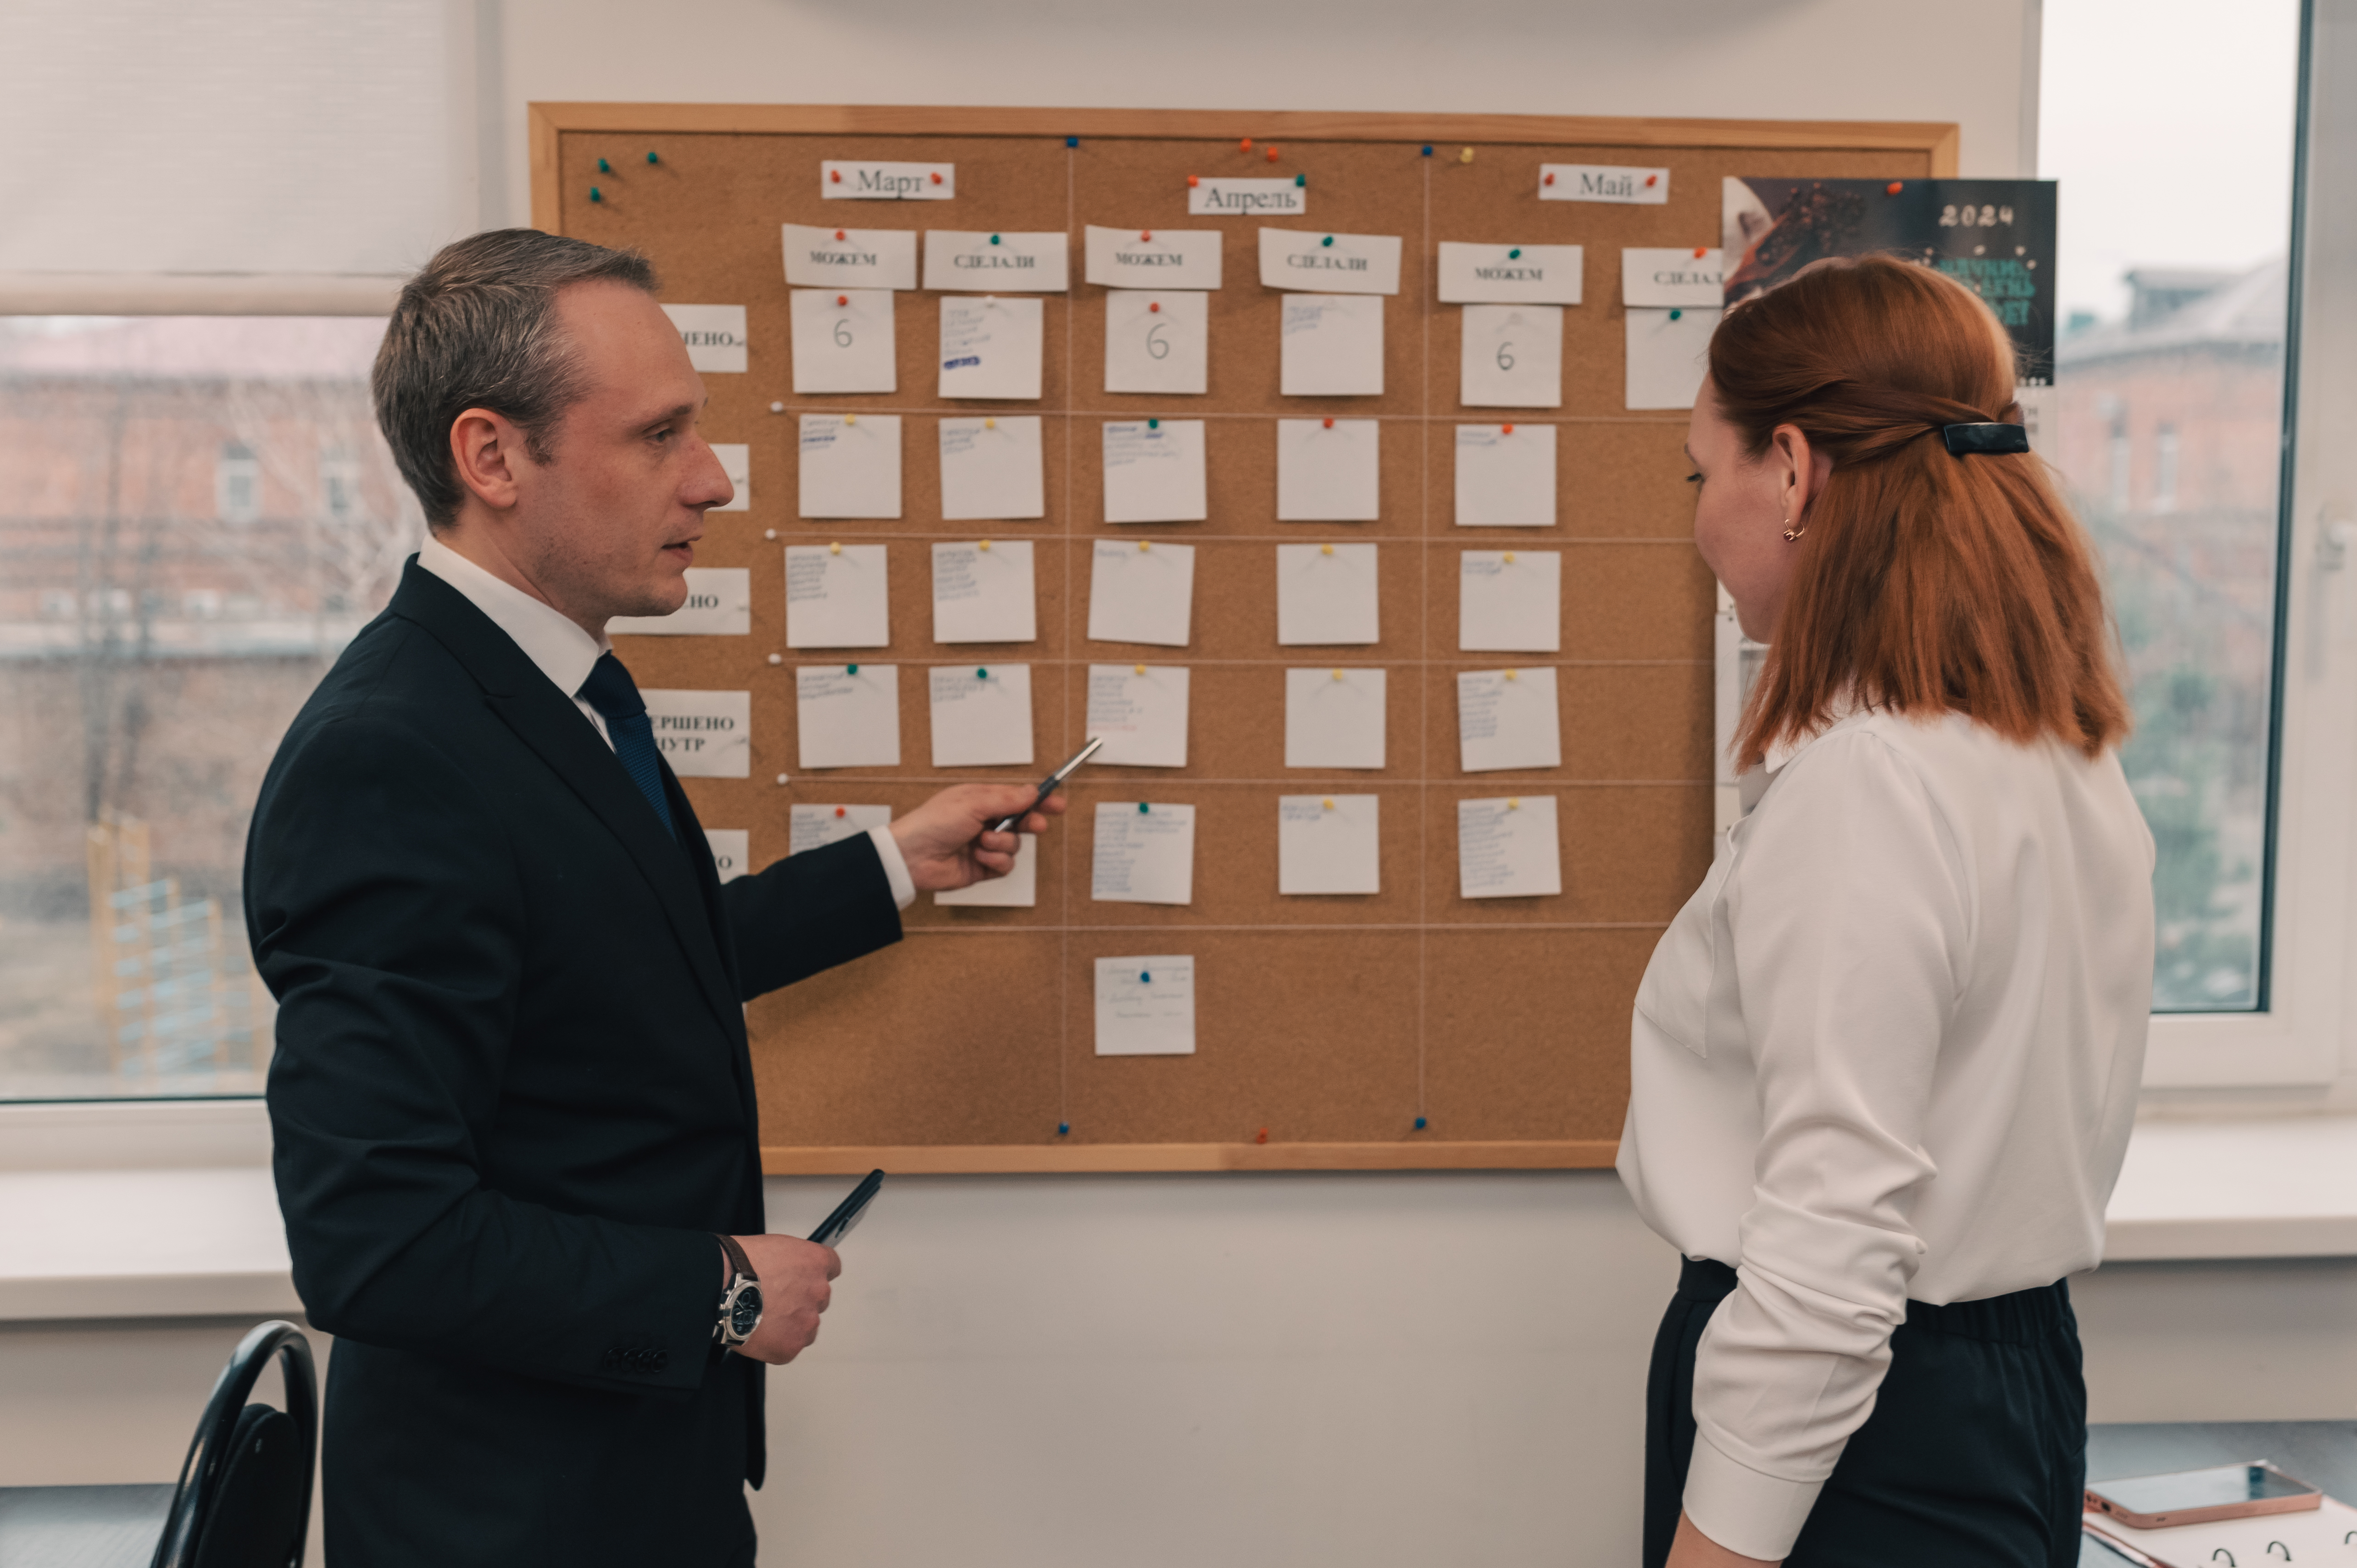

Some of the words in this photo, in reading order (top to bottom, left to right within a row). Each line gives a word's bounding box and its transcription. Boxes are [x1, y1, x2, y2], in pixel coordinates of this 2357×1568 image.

[857, 169, 923, 198] Март
[1580, 172, 1633, 197] Май
[1204, 187, 1297, 213] Апрель
[1939, 205, 2014, 227] 2024
[809, 250, 877, 266] МОЖЕМ
[953, 254, 1035, 269] СДЕЛАЛИ
[1115, 252, 1183, 267] МОЖЕМ
[1286, 254, 1368, 271] СДЕЛАЛИ
[1474, 267, 1543, 281] МОЖЕМ
[1653, 271, 1723, 286] СДЕЛАЛ
[833, 318, 853, 348] 6
[1146, 322, 1170, 360] 6
[1495, 341, 1515, 371] 6
[649, 715, 735, 731] ЕРШЕНО
